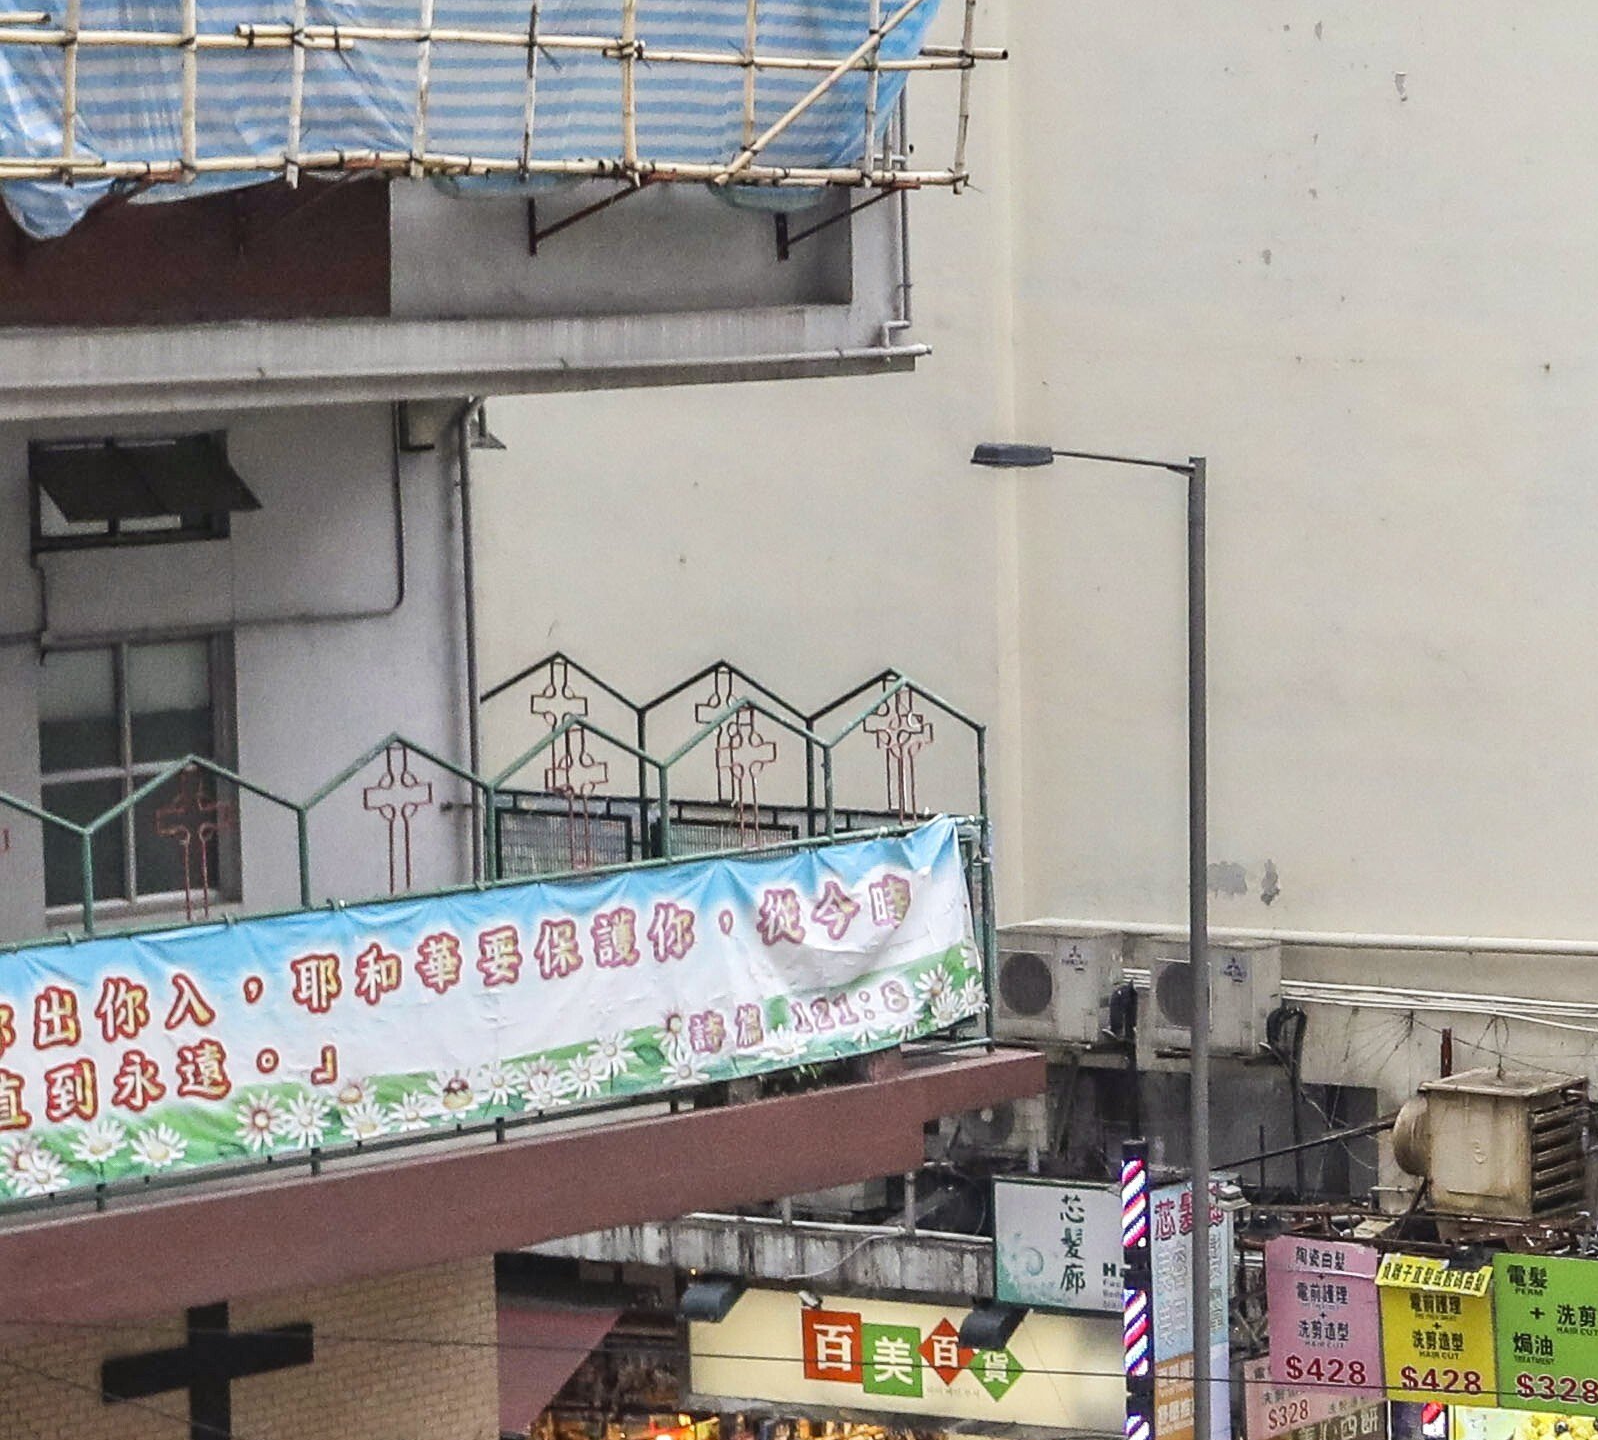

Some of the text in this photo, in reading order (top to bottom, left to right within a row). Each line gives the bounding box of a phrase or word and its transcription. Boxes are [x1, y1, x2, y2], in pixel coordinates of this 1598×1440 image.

[689, 1004, 764, 1055] 詩篇
[1060, 1193, 1086, 1295] 芯髮廊
[1507, 1264, 1548, 1290] 電髮
[1515, 1287, 1544, 1297] PERM
[1556, 1304, 1597, 1328] 洗剪
[1299, 1320, 1349, 1342] 洗剪造型
[1411, 1330, 1465, 1352] 洗剪造型
[1556, 1325, 1598, 1337] HAIR CUT
[811, 1323, 1011, 1386] 百美百貨
[1513, 1332, 1554, 1357] 焗油
[1286, 1354, 1367, 1385] $428
[1400, 1365, 1482, 1394] $428
